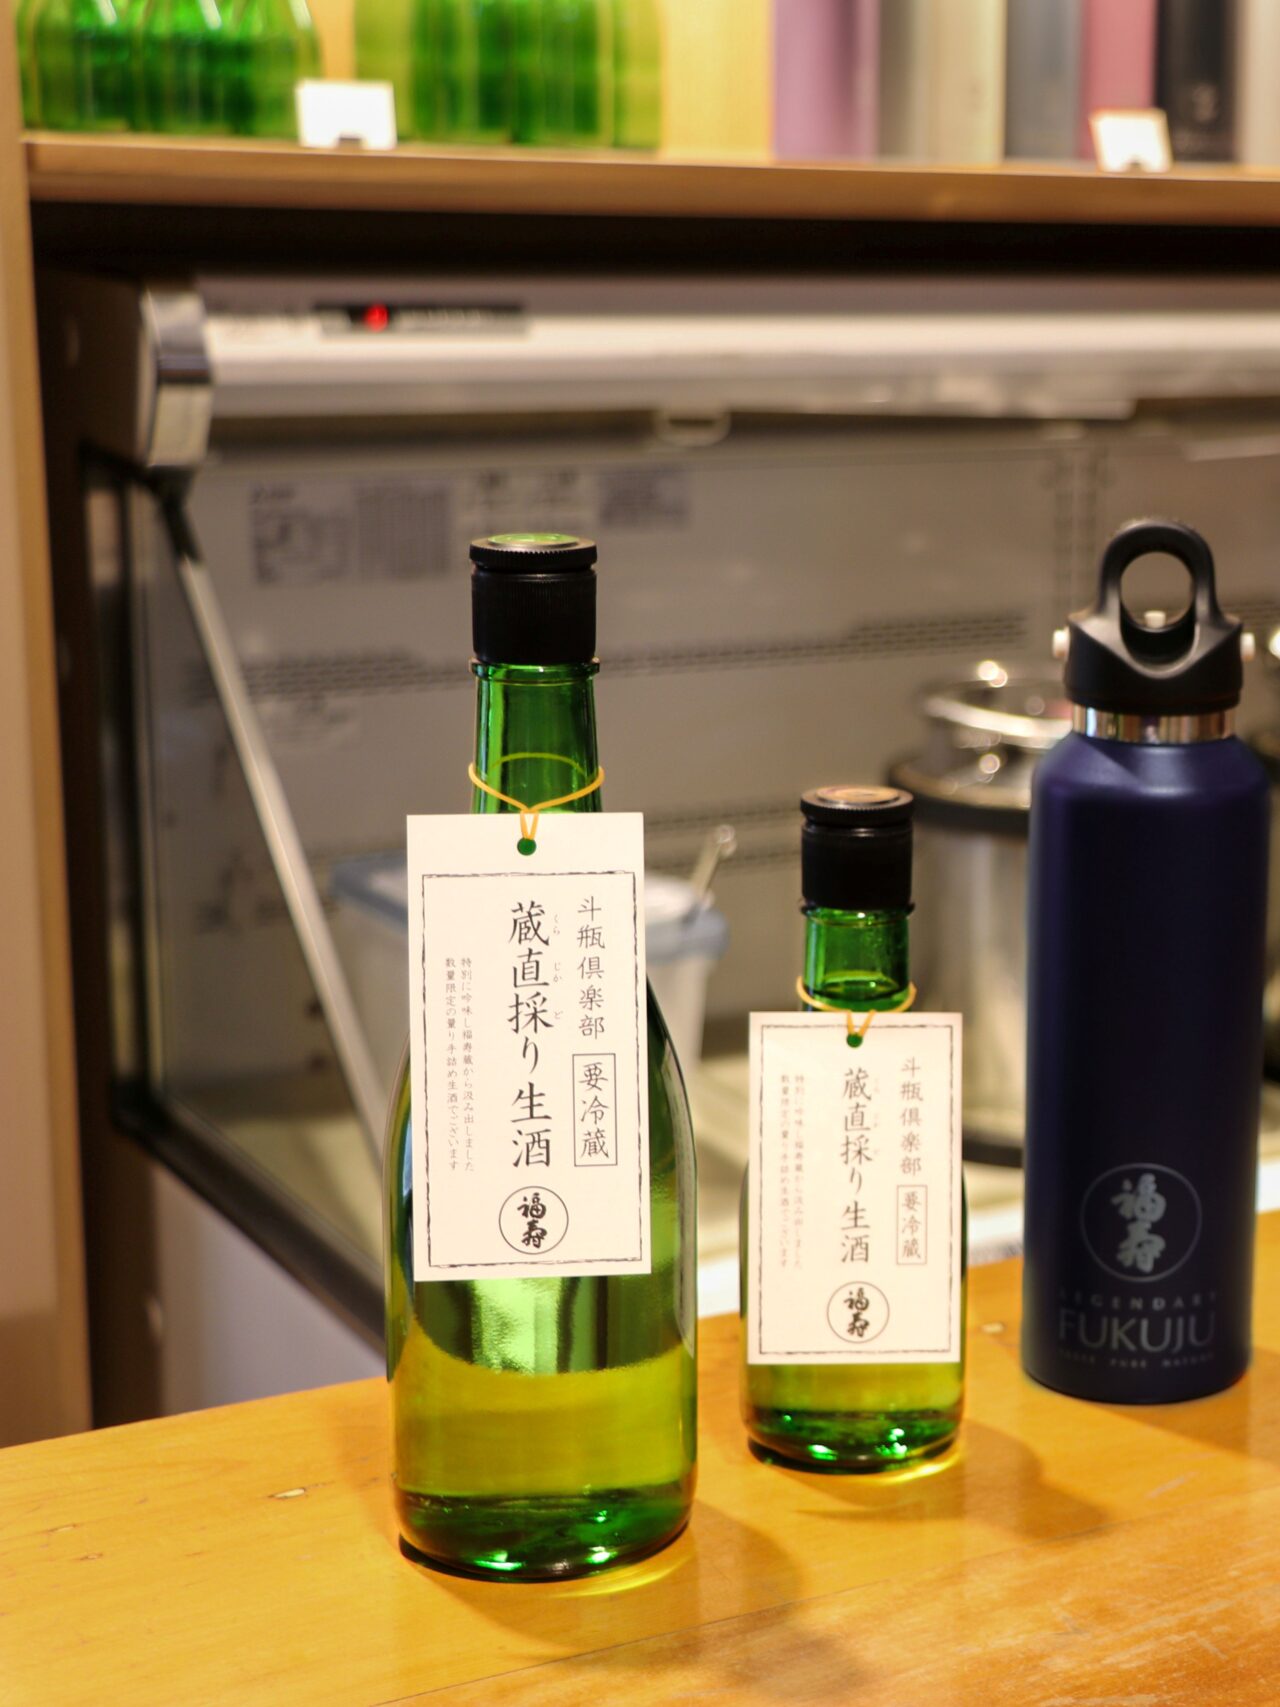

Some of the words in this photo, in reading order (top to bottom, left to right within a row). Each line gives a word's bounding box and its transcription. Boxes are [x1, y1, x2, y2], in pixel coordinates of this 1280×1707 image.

[577, 896, 606, 1040] 斗瓶倶楽部
[508, 900, 555, 1169] 蔵直採り生酒
[577, 1060, 610, 1159] 要冷蔵
[841, 1067, 873, 1264] 蔵直採り生酒
[516, 1192, 548, 1249] 福寿
[902, 1191, 922, 1259] 要冷蔵
[1058, 1307, 1216, 1354] FUKUJU
